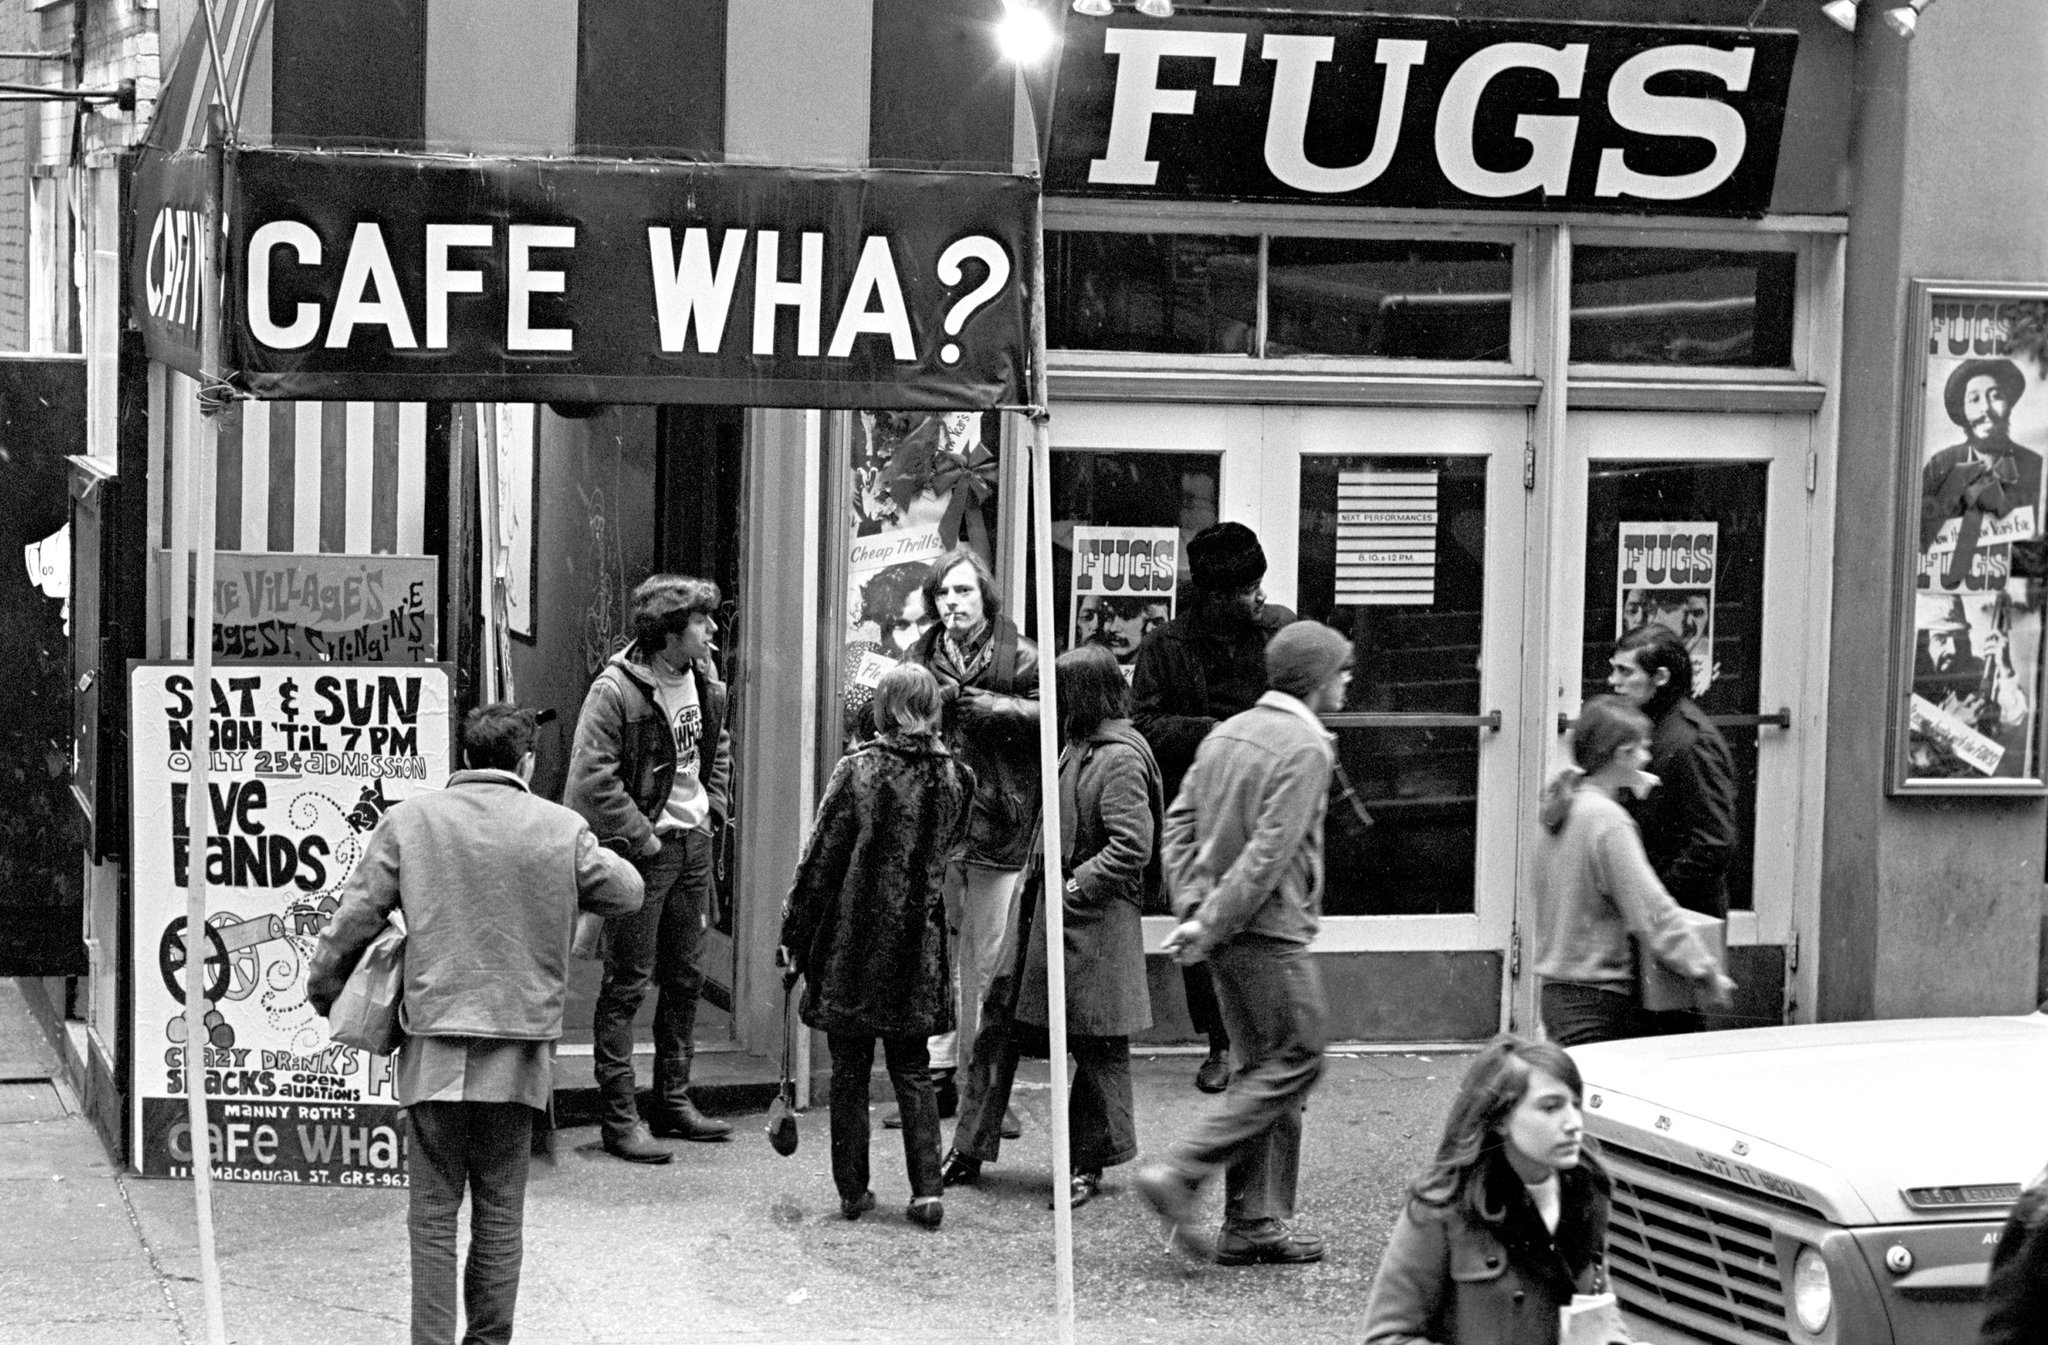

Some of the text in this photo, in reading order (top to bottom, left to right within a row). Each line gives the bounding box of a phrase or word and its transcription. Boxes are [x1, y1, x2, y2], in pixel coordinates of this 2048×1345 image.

[1088, 28, 1755, 201] FUGS
[247, 220, 576, 350] CAFE
[647, 226, 1011, 365] WHA?
[850, 545, 893, 563] Cheap
[1077, 539, 1175, 591] FUGS
[1622, 534, 1714, 584] FUGS
[861, 662, 882, 680] Fle
[165, 675, 422, 726] SAT & SUN
[341, 726, 362, 751] 7
[369, 726, 418, 756] PM
[168, 751, 248, 773] OLY
[255, 750, 302, 774] 25¢
[171, 779, 267, 835] LVe
[164, 1047, 252, 1068] CaZY
[298, 1105, 356, 1120] ROTH'S
